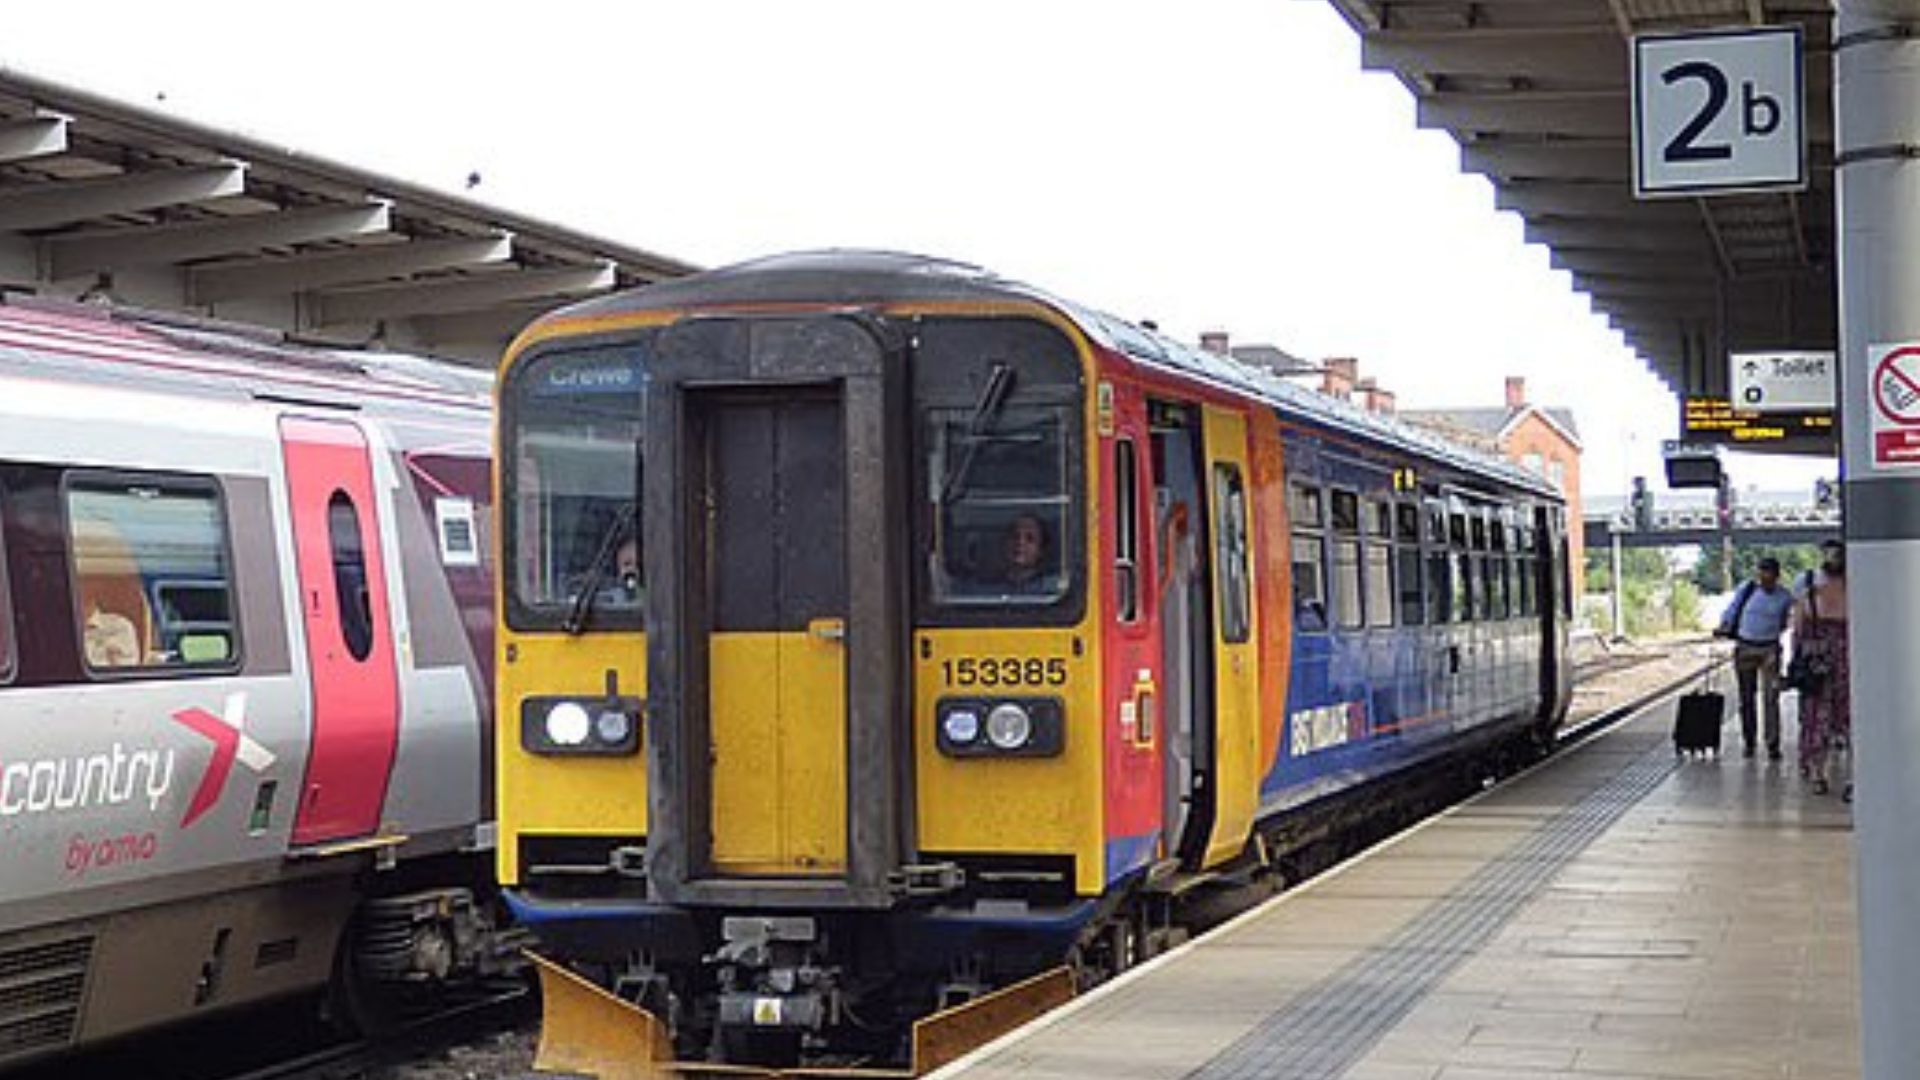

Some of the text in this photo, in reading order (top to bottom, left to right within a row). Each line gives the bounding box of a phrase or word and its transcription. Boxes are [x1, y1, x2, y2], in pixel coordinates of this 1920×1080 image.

[1770, 358, 1825, 377] Toilet
[942, 657, 1067, 687] 153385
[0, 742, 175, 815] country
